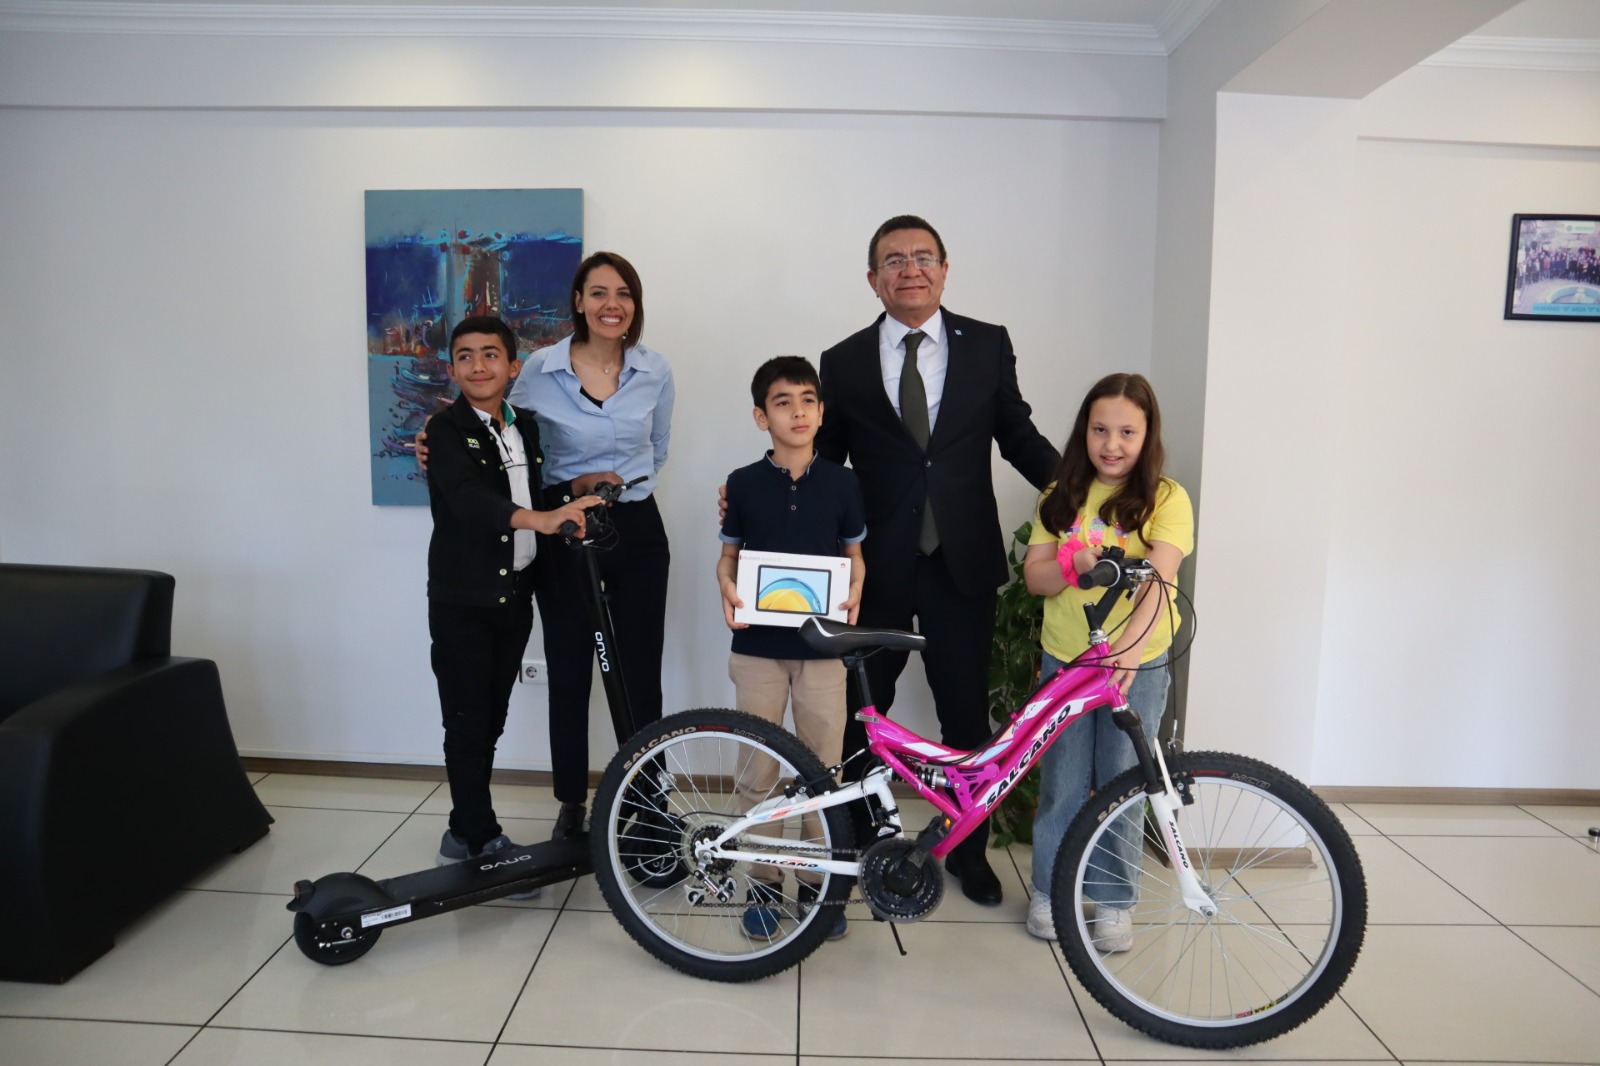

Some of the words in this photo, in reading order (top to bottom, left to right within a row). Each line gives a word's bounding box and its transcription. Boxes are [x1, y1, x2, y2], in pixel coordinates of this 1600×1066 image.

[623, 726, 697, 771] SALCANO
[985, 704, 1071, 811] SALCANO
[753, 857, 819, 869] SALCANO
[1168, 820, 1189, 869] SALCANO
